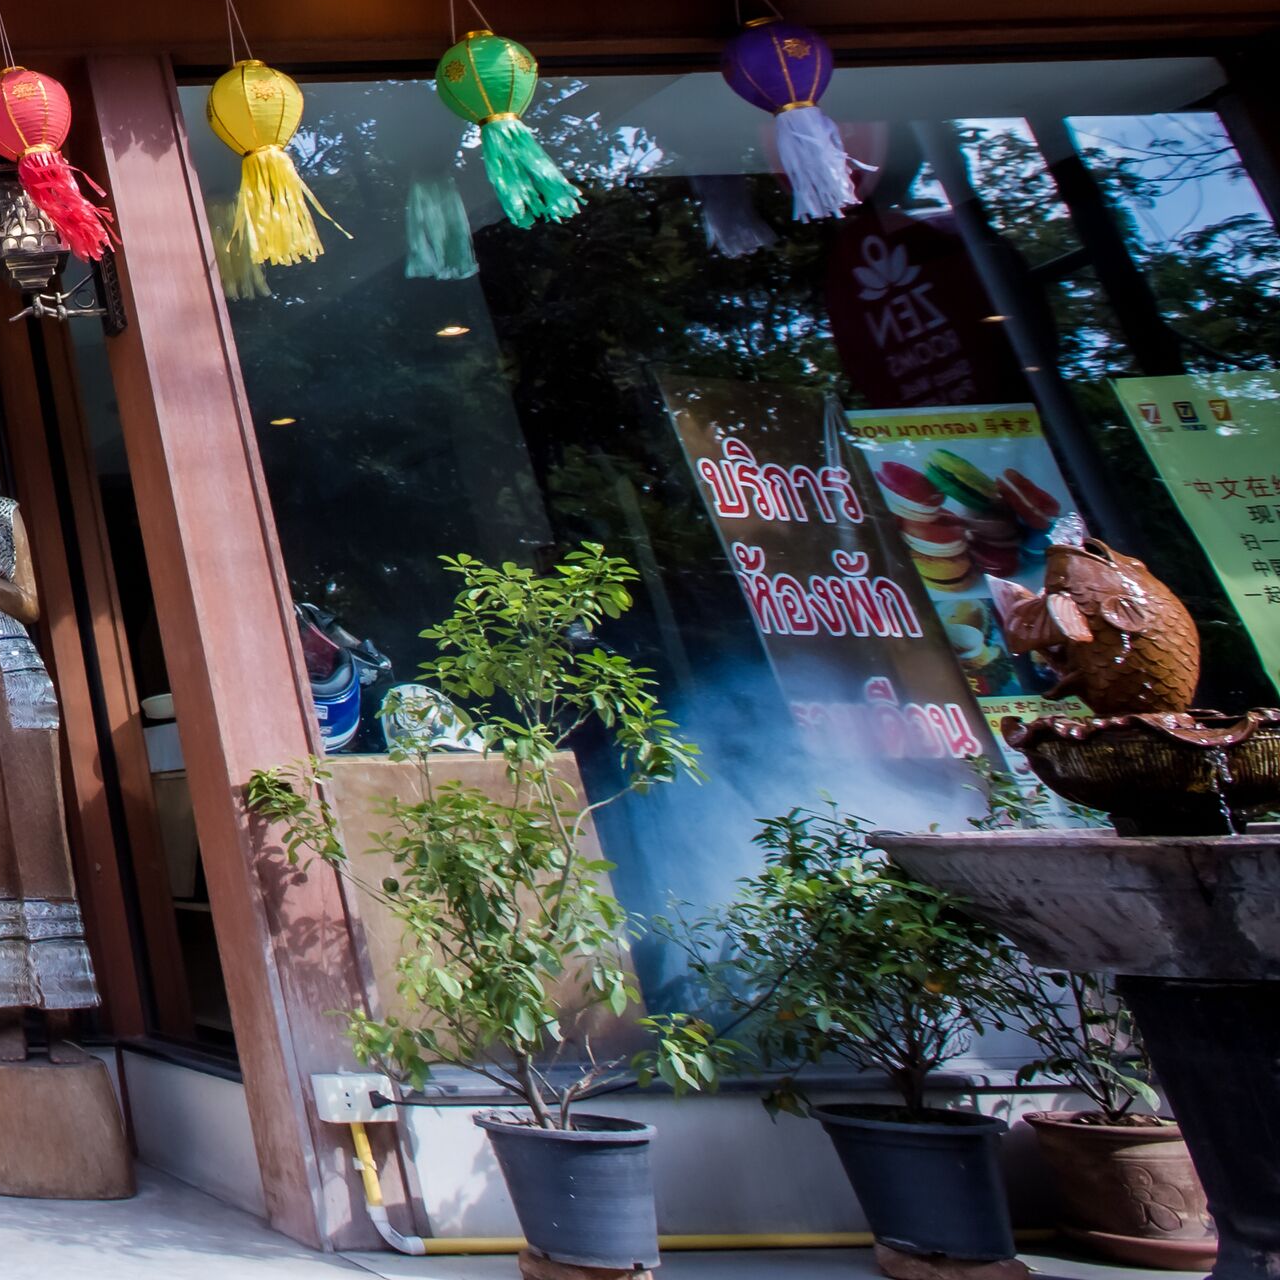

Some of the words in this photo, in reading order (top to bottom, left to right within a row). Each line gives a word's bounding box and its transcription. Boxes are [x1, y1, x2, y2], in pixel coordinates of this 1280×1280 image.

[696, 437, 864, 524] บริการ
[732, 542, 924, 638] ห้องพัก
